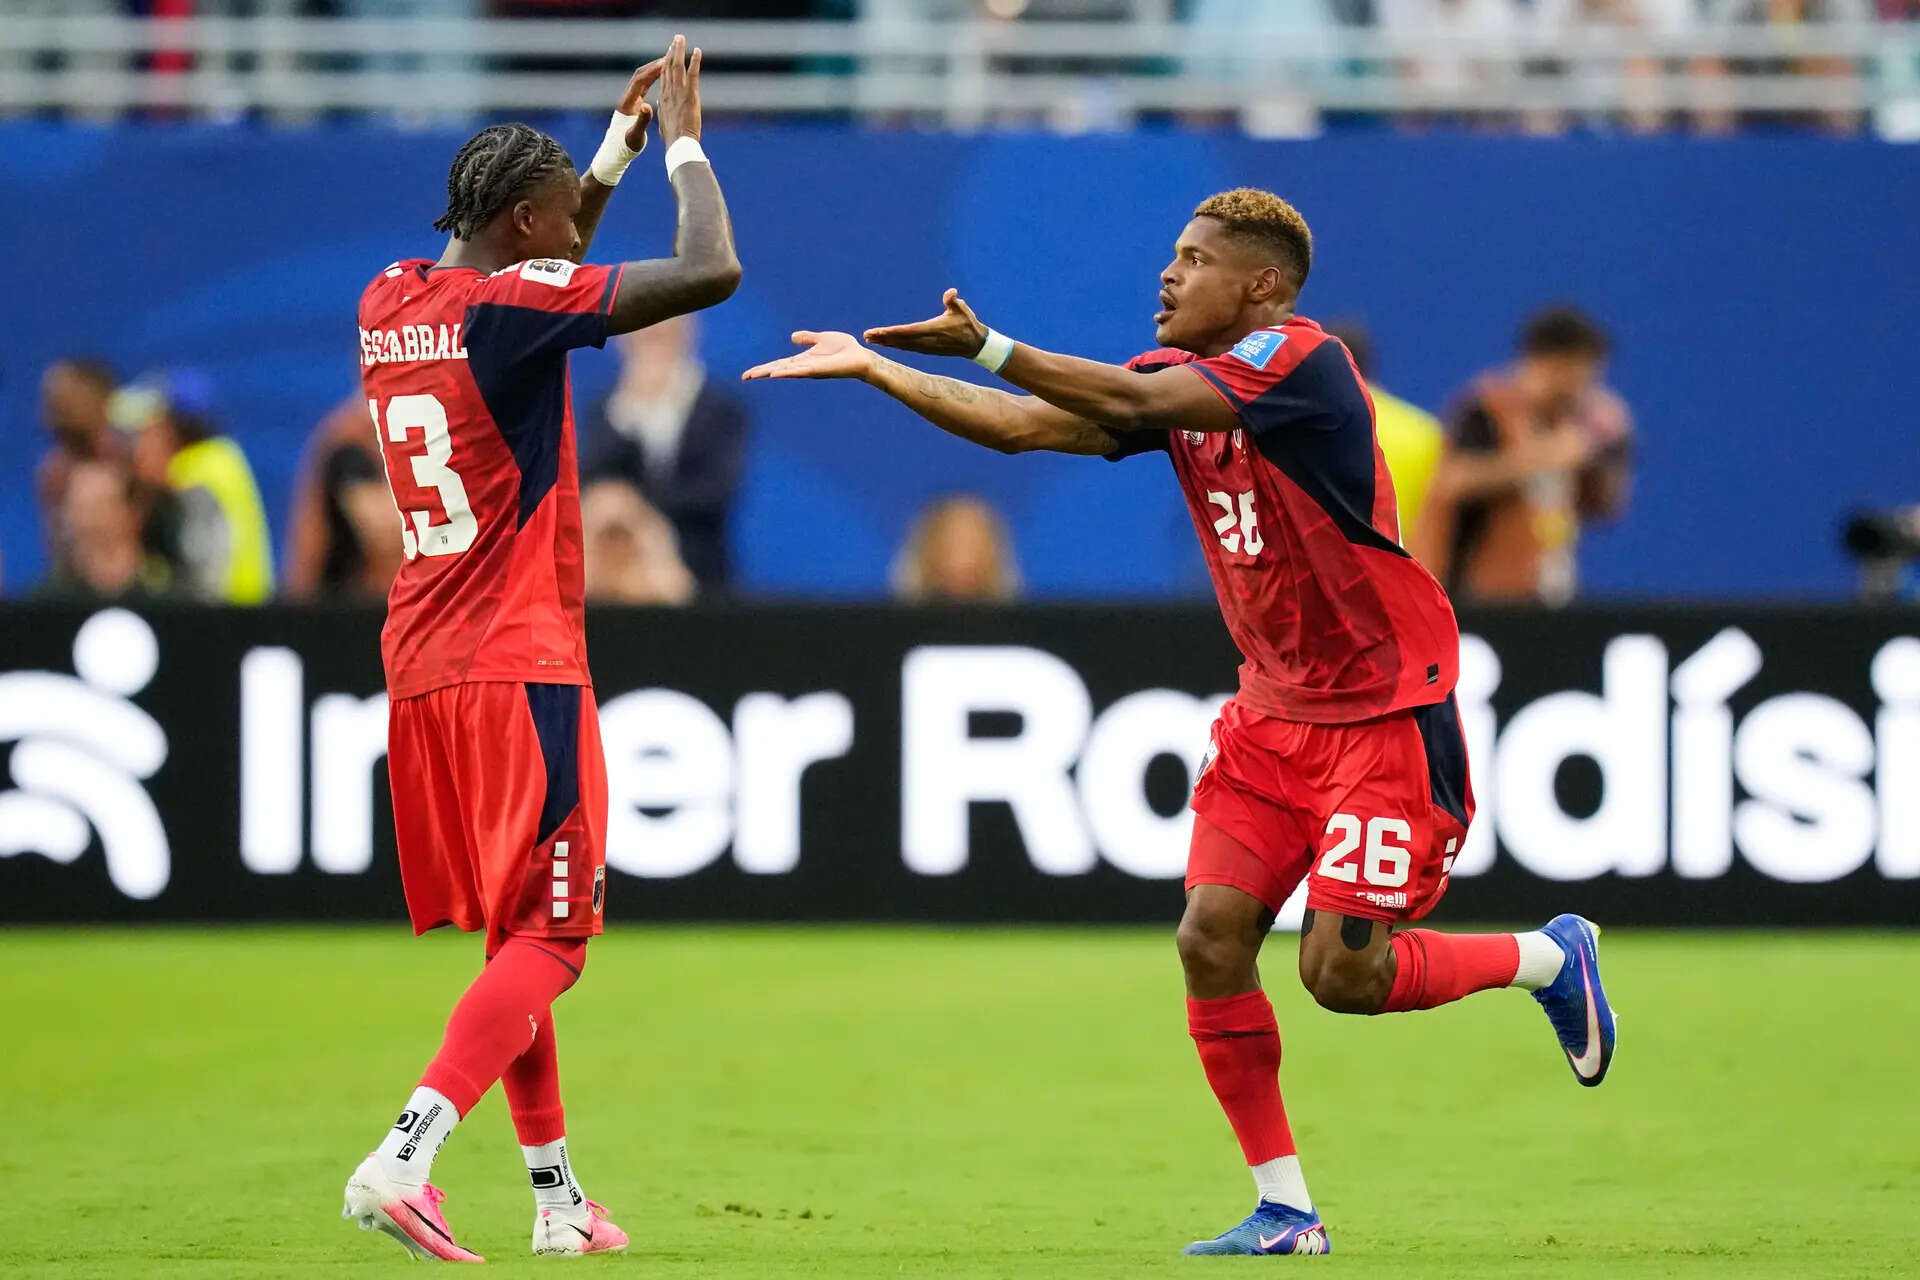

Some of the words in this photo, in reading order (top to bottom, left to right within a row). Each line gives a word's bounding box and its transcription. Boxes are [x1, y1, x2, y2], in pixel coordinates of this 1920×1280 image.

[1207, 489, 1264, 556] 26
[240, 645, 855, 879] Iner
[899, 626, 1920, 928] Raidísi
[1317, 813, 1411, 887] 26
[408, 1103, 443, 1145] TAPEDESIGN
